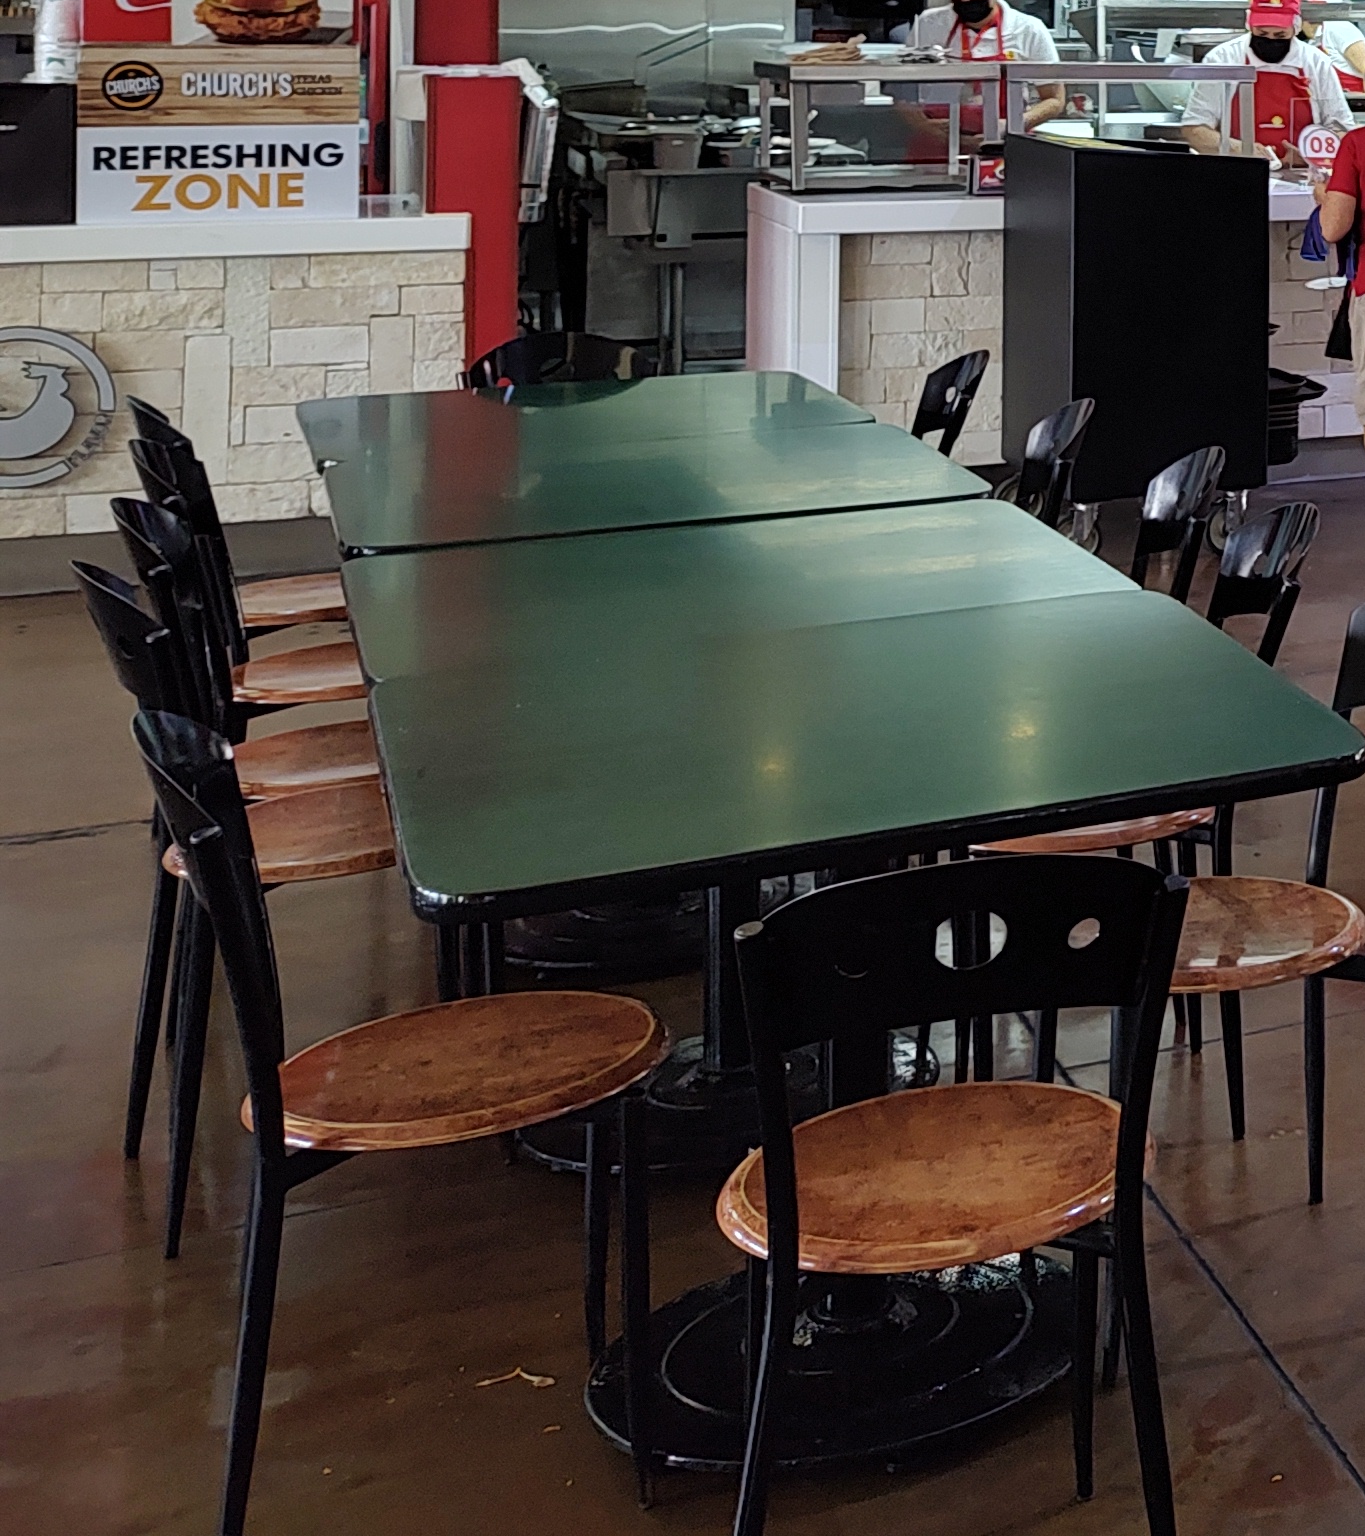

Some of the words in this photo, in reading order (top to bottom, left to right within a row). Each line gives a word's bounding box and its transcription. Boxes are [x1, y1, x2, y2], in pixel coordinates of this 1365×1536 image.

[181, 71, 293, 98] CHURCH'S
[93, 143, 344, 170] REFRESHING
[1310, 137, 1335, 153] 08
[131, 173, 304, 212] ZONE
